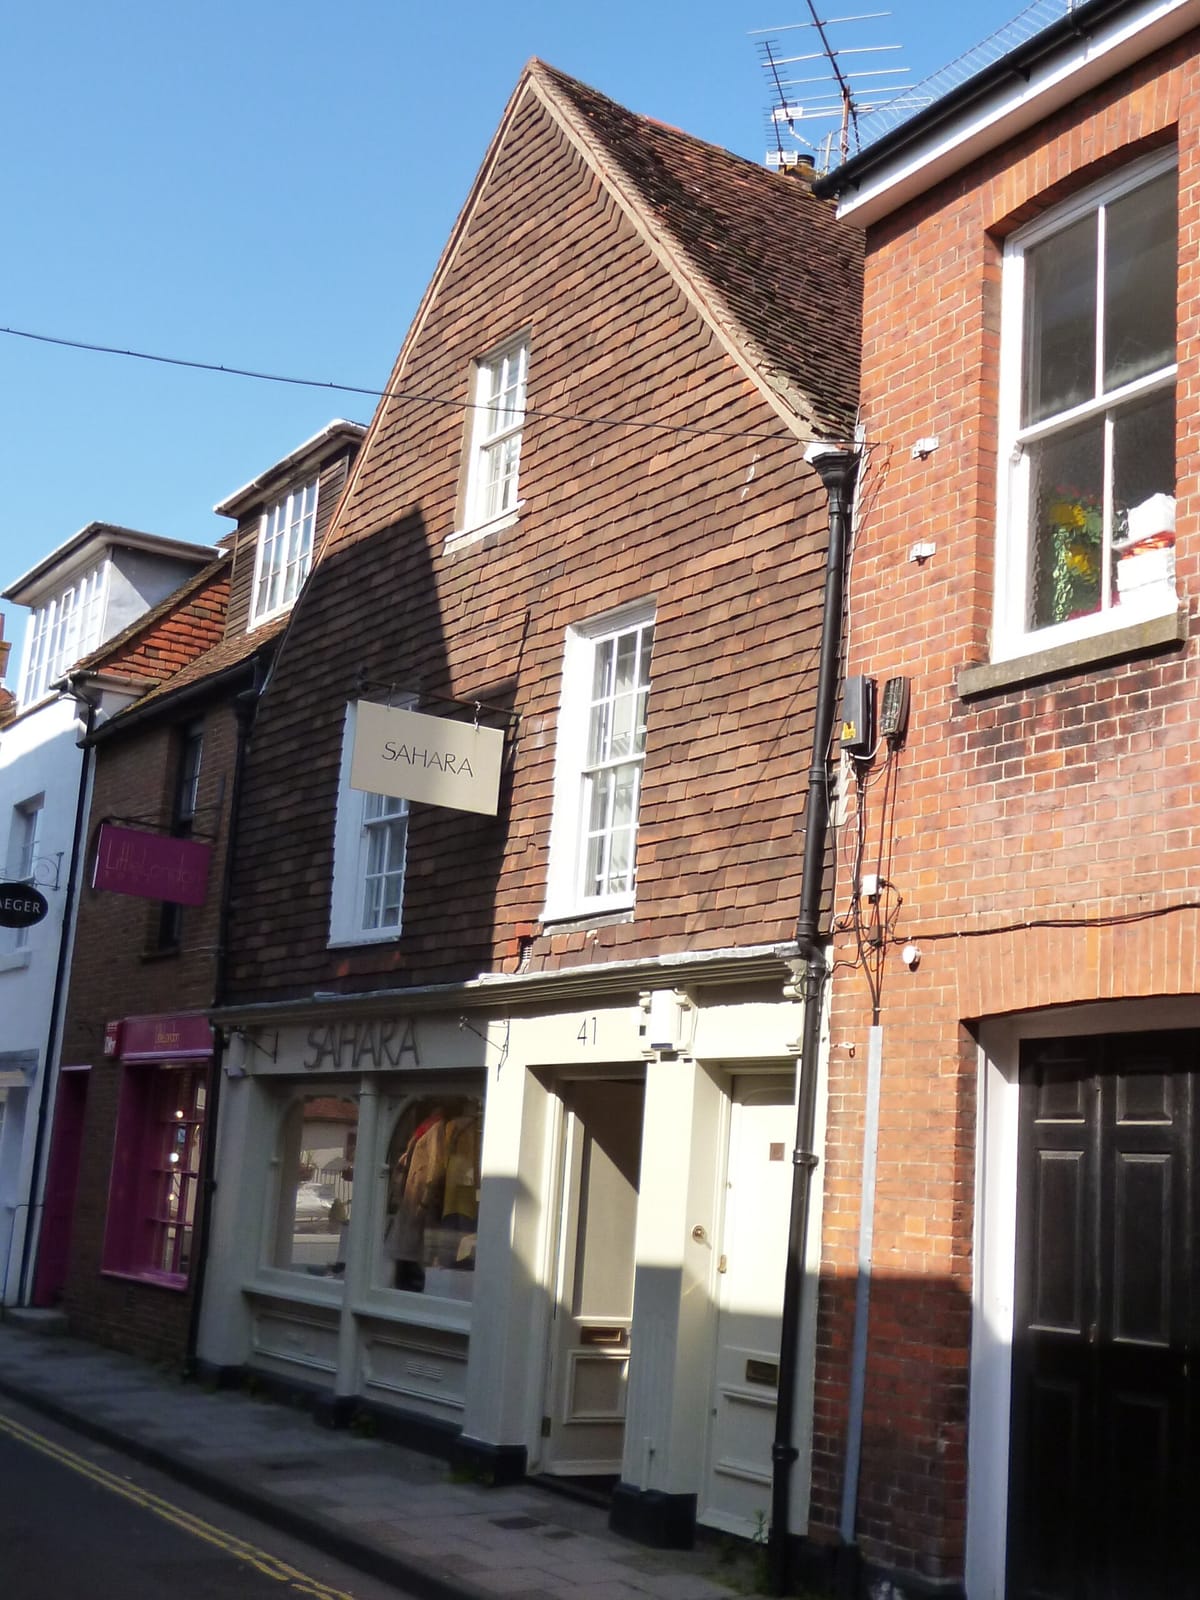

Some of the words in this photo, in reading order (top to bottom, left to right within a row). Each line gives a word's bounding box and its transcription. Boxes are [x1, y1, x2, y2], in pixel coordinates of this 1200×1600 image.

[382, 741, 474, 778] SAHARA
[304, 1020, 420, 1070] SAHARA
[577, 1016, 597, 1046] 41
